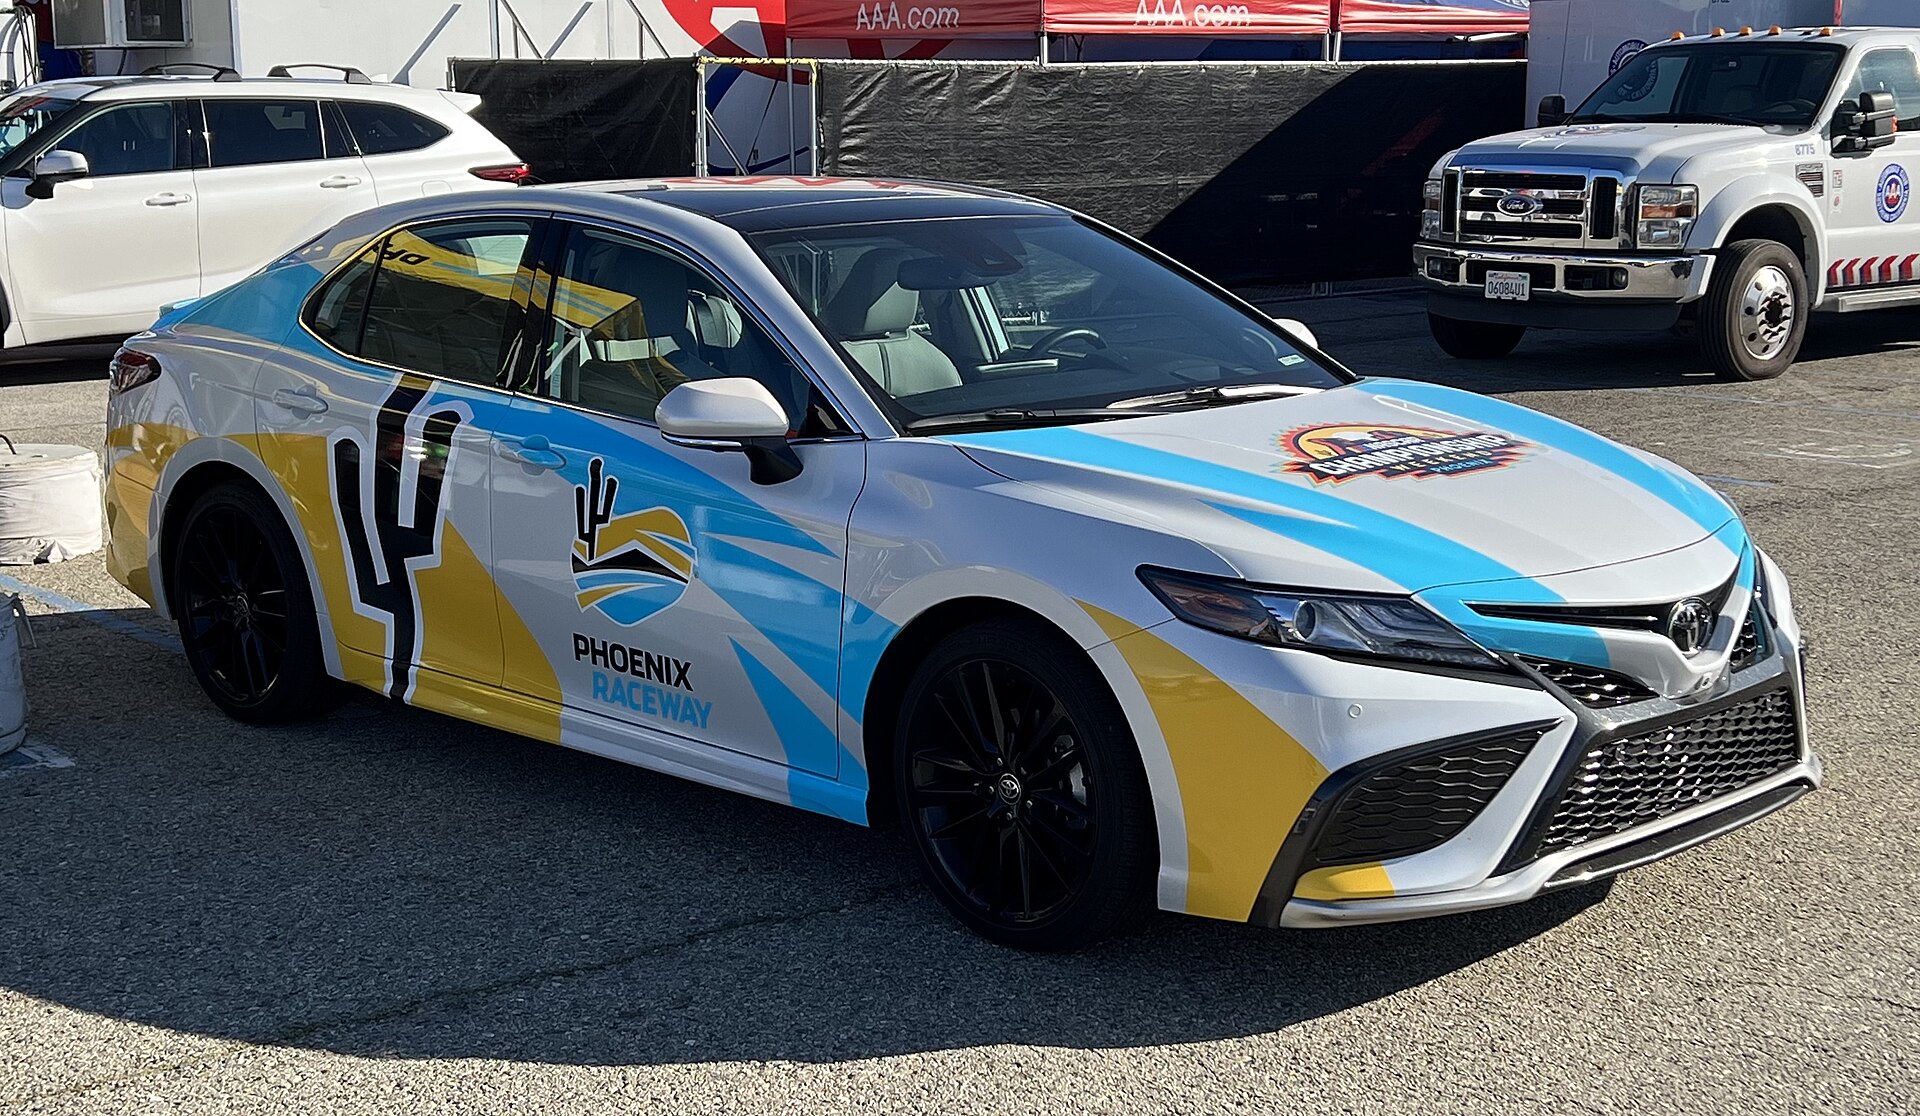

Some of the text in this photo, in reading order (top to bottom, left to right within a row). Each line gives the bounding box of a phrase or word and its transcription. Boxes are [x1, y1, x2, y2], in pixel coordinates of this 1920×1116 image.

[855, 1, 960, 31] AAA.com
[1133, 0, 1251, 27] AAA.com
[1794, 143, 1816, 156] 8775
[1506, 200, 1526, 211] Ford
[1308, 434, 1506, 475] CHAMPIONSHIP
[1390, 450, 1493, 471] WEEKEND
[1430, 457, 1494, 473] PHOENIX
[573, 632, 694, 692] PHOENIX
[592, 671, 713, 729] RACEWAY
